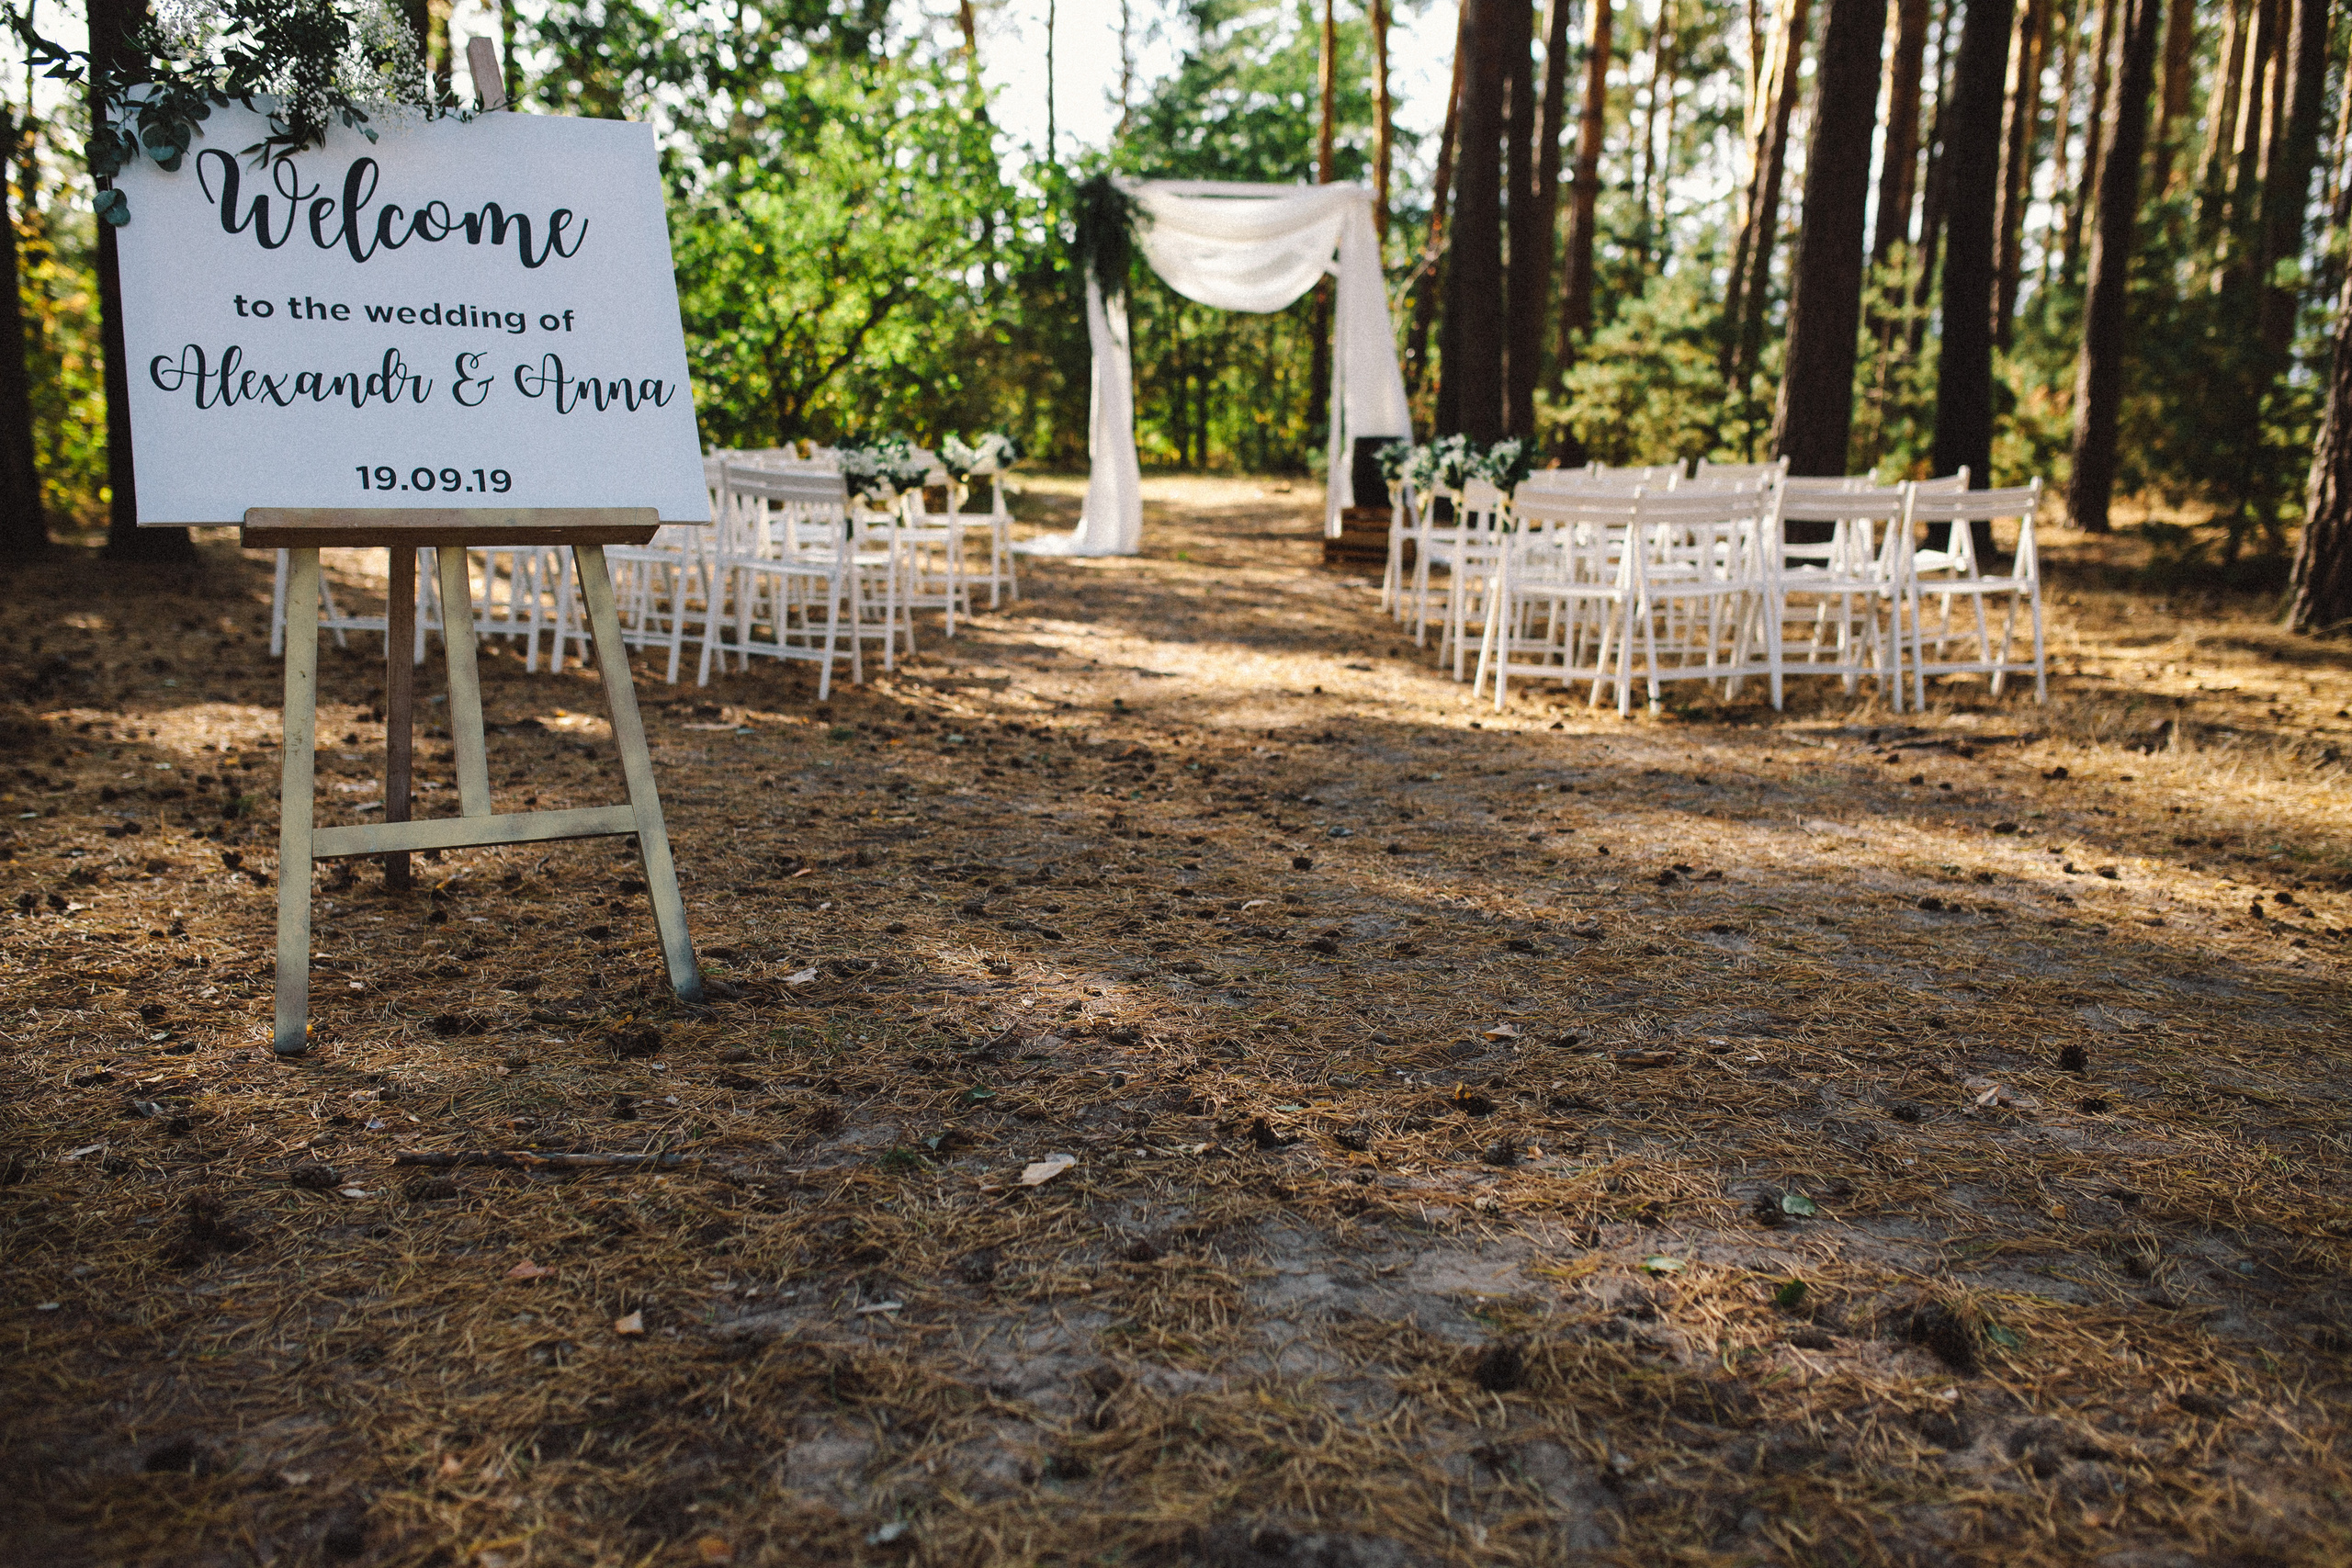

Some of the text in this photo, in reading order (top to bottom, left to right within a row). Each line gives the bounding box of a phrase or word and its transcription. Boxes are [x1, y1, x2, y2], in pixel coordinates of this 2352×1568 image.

[196, 148, 589, 268] Welcome
[233, 294, 575, 334] to the wedding of
[150, 344, 676, 415] Alexandr & Anna
[356, 466, 512, 493] 19.09.19
